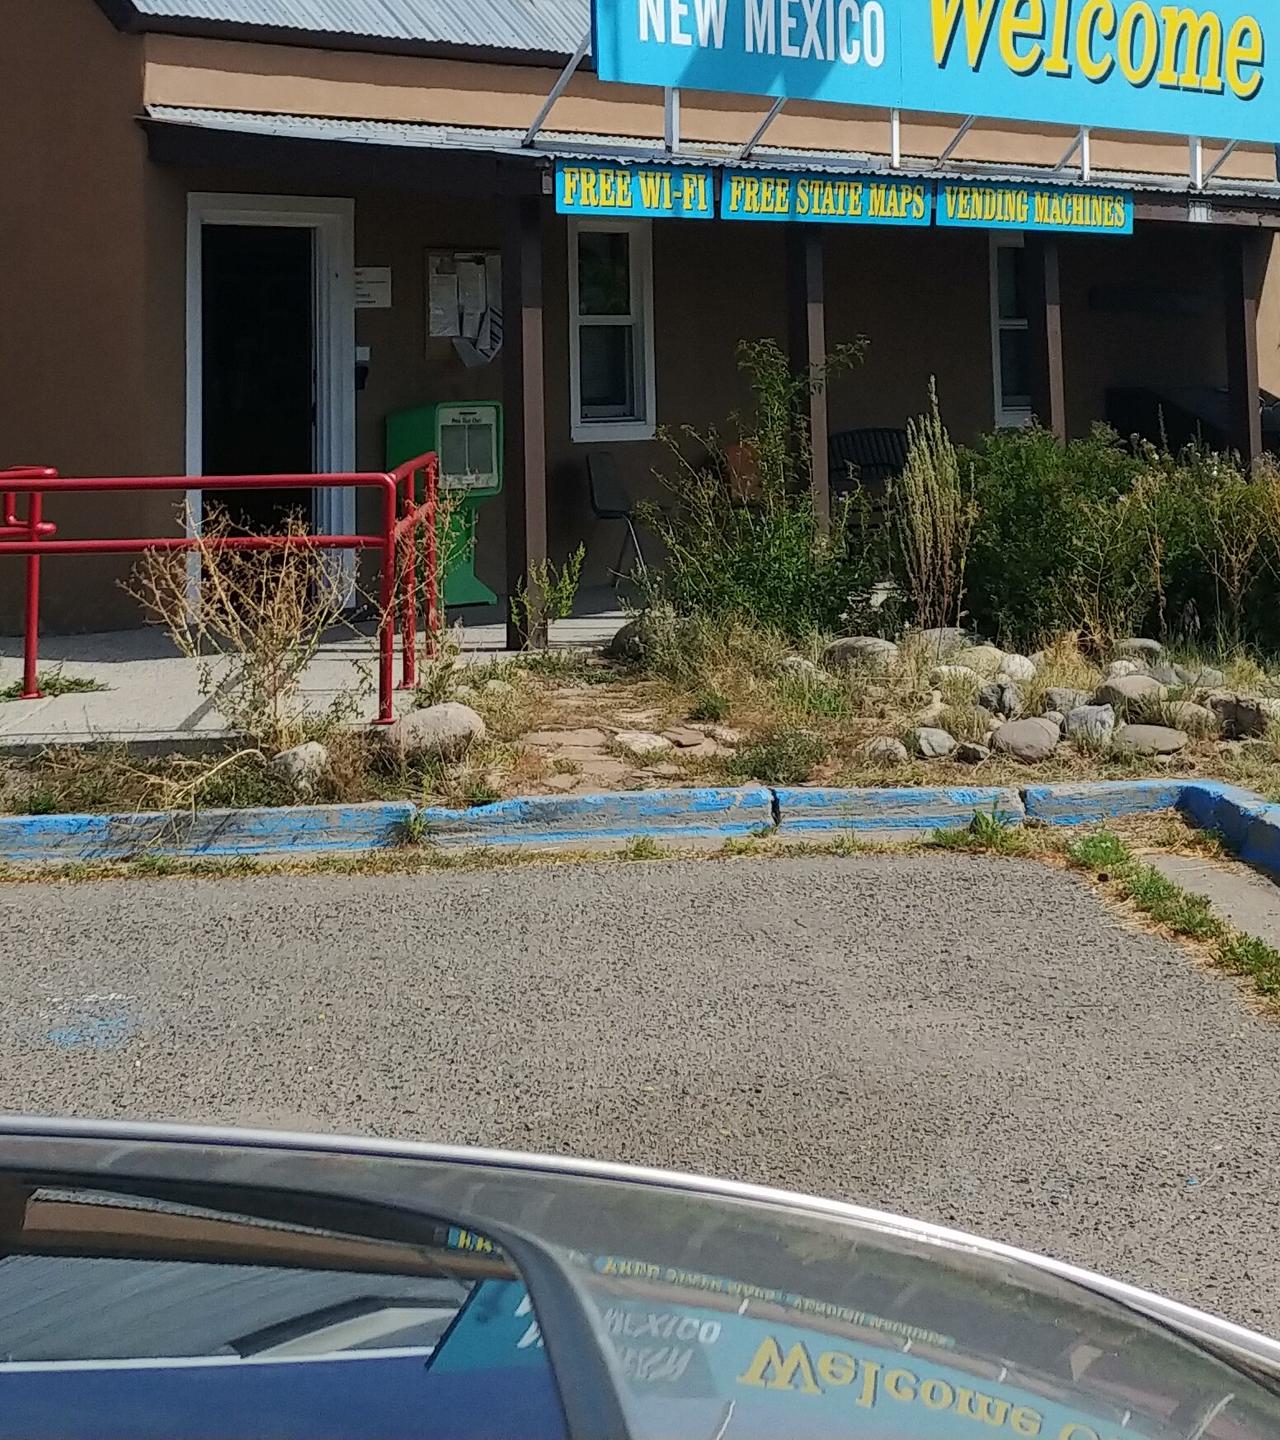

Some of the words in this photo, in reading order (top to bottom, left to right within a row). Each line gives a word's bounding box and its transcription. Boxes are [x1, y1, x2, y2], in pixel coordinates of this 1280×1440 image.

[563, 167, 634, 208] FREE
[638, 171, 708, 211] WI-FI
[729, 175, 790, 214] FREE
[795, 178, 864, 217] STATE
[868, 183, 926, 220] MAPS
[944, 186, 1029, 223] VENDING
[1033, 191, 1126, 228] MACHINES
